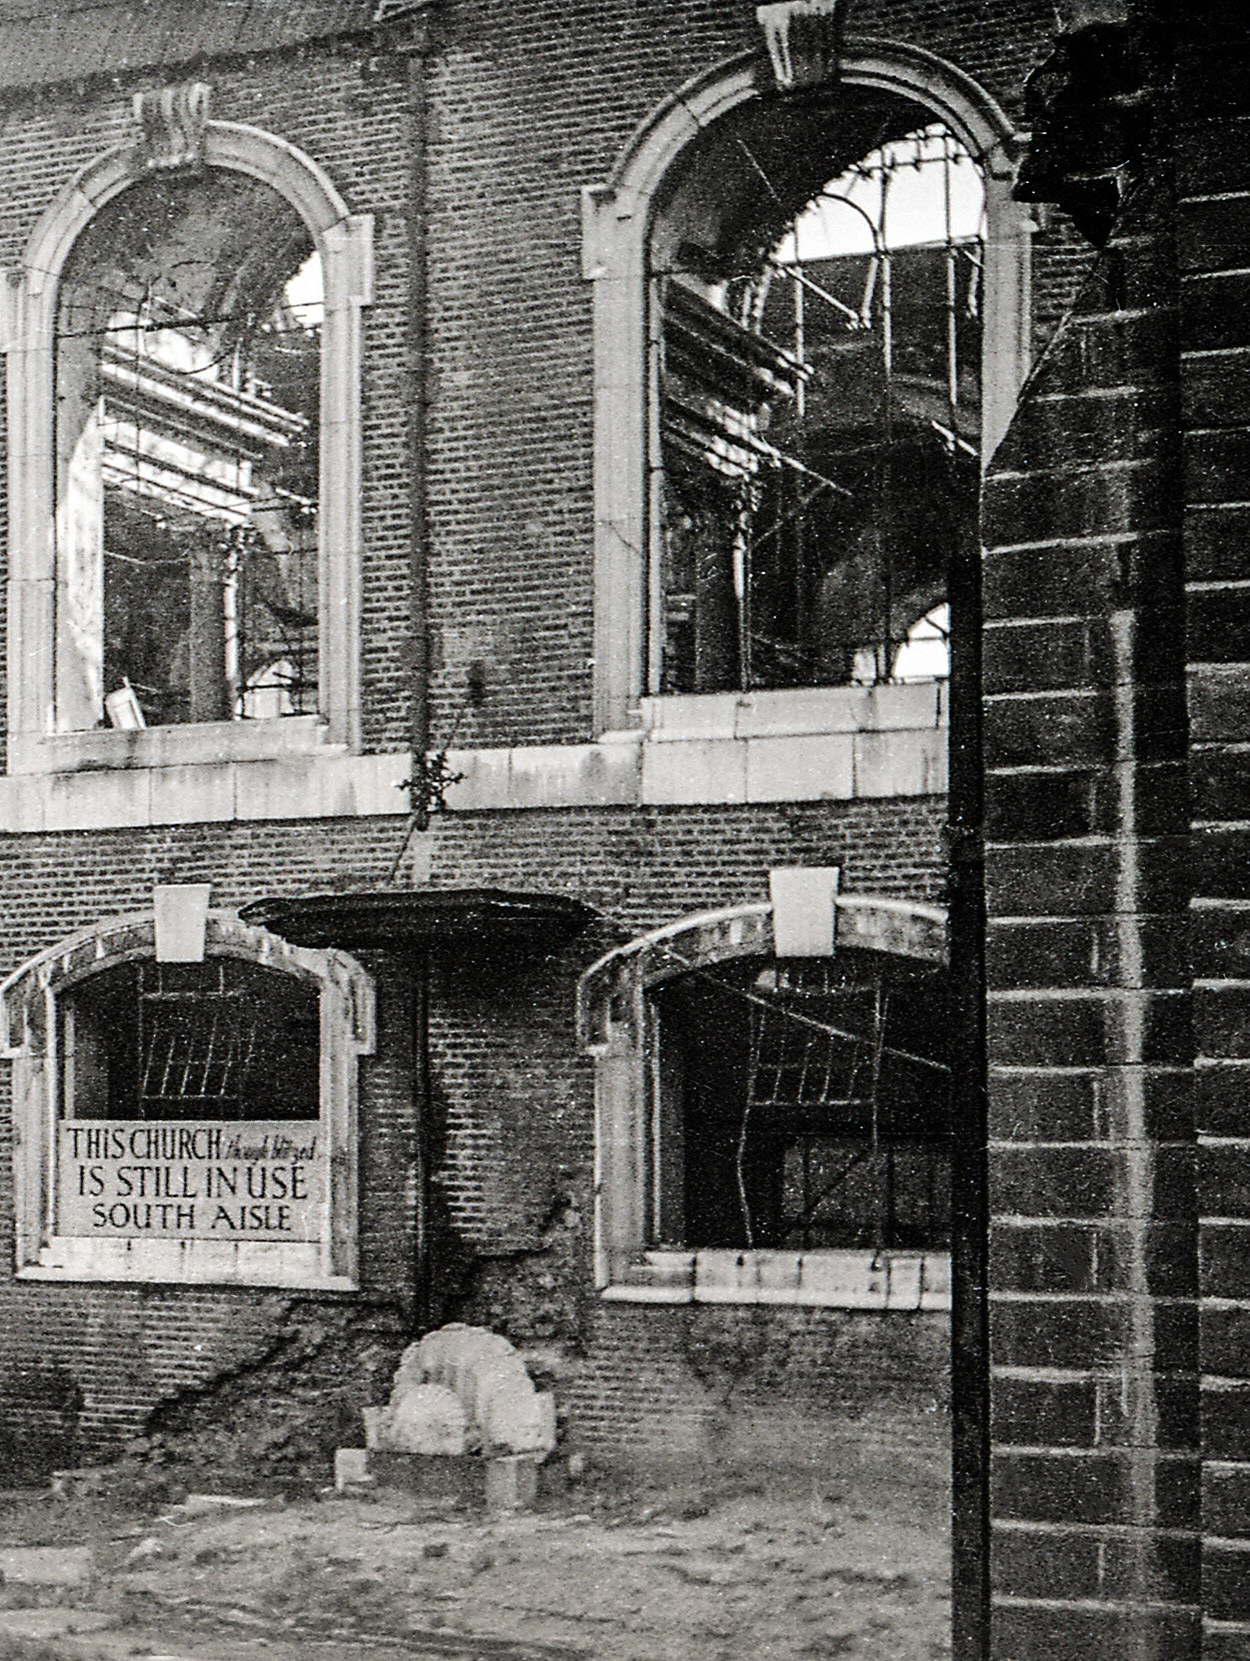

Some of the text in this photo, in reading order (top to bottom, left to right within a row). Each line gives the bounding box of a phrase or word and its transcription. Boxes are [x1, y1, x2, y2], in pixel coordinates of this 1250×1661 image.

[129, 1127, 223, 1160] CHURCH
[78, 1165, 308, 1200] IS STILL IN USE
[92, 1203, 292, 1231] SOUTH AISLE
